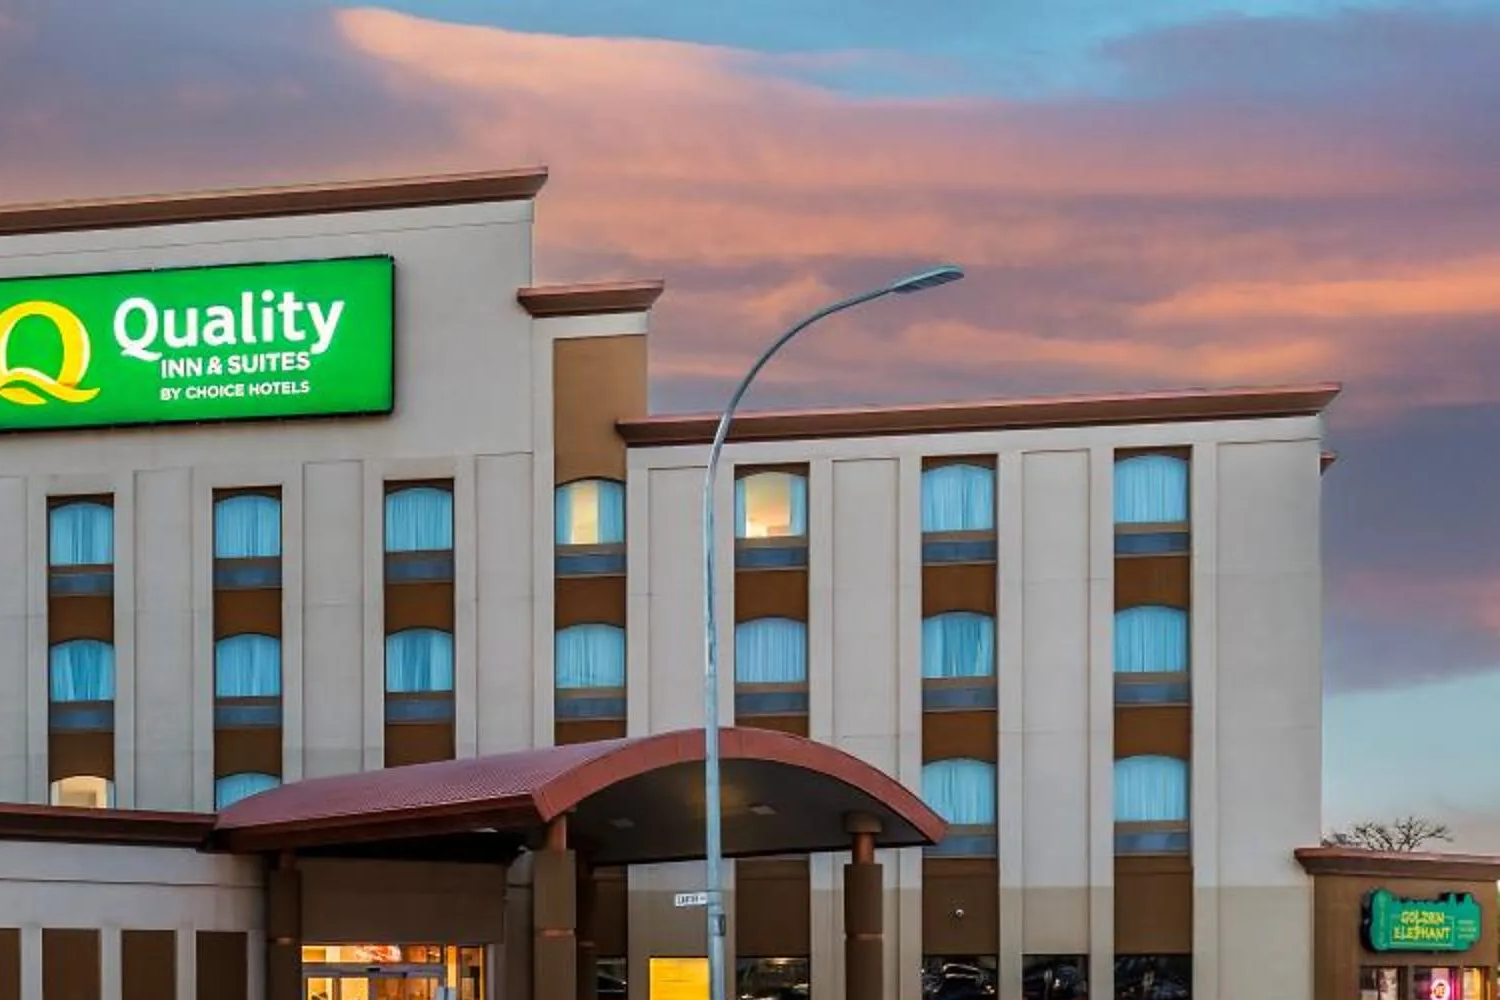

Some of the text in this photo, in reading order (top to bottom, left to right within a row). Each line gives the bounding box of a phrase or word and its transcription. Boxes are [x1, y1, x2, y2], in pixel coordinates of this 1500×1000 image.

[113, 290, 345, 362] Quality
[161, 352, 311, 379] INN & SUITES
[160, 380, 310, 401] BY CHOICE HOTELS
[1400, 911, 1445, 925] GOLDEN
[1393, 927, 1451, 940] ELEPHANT
